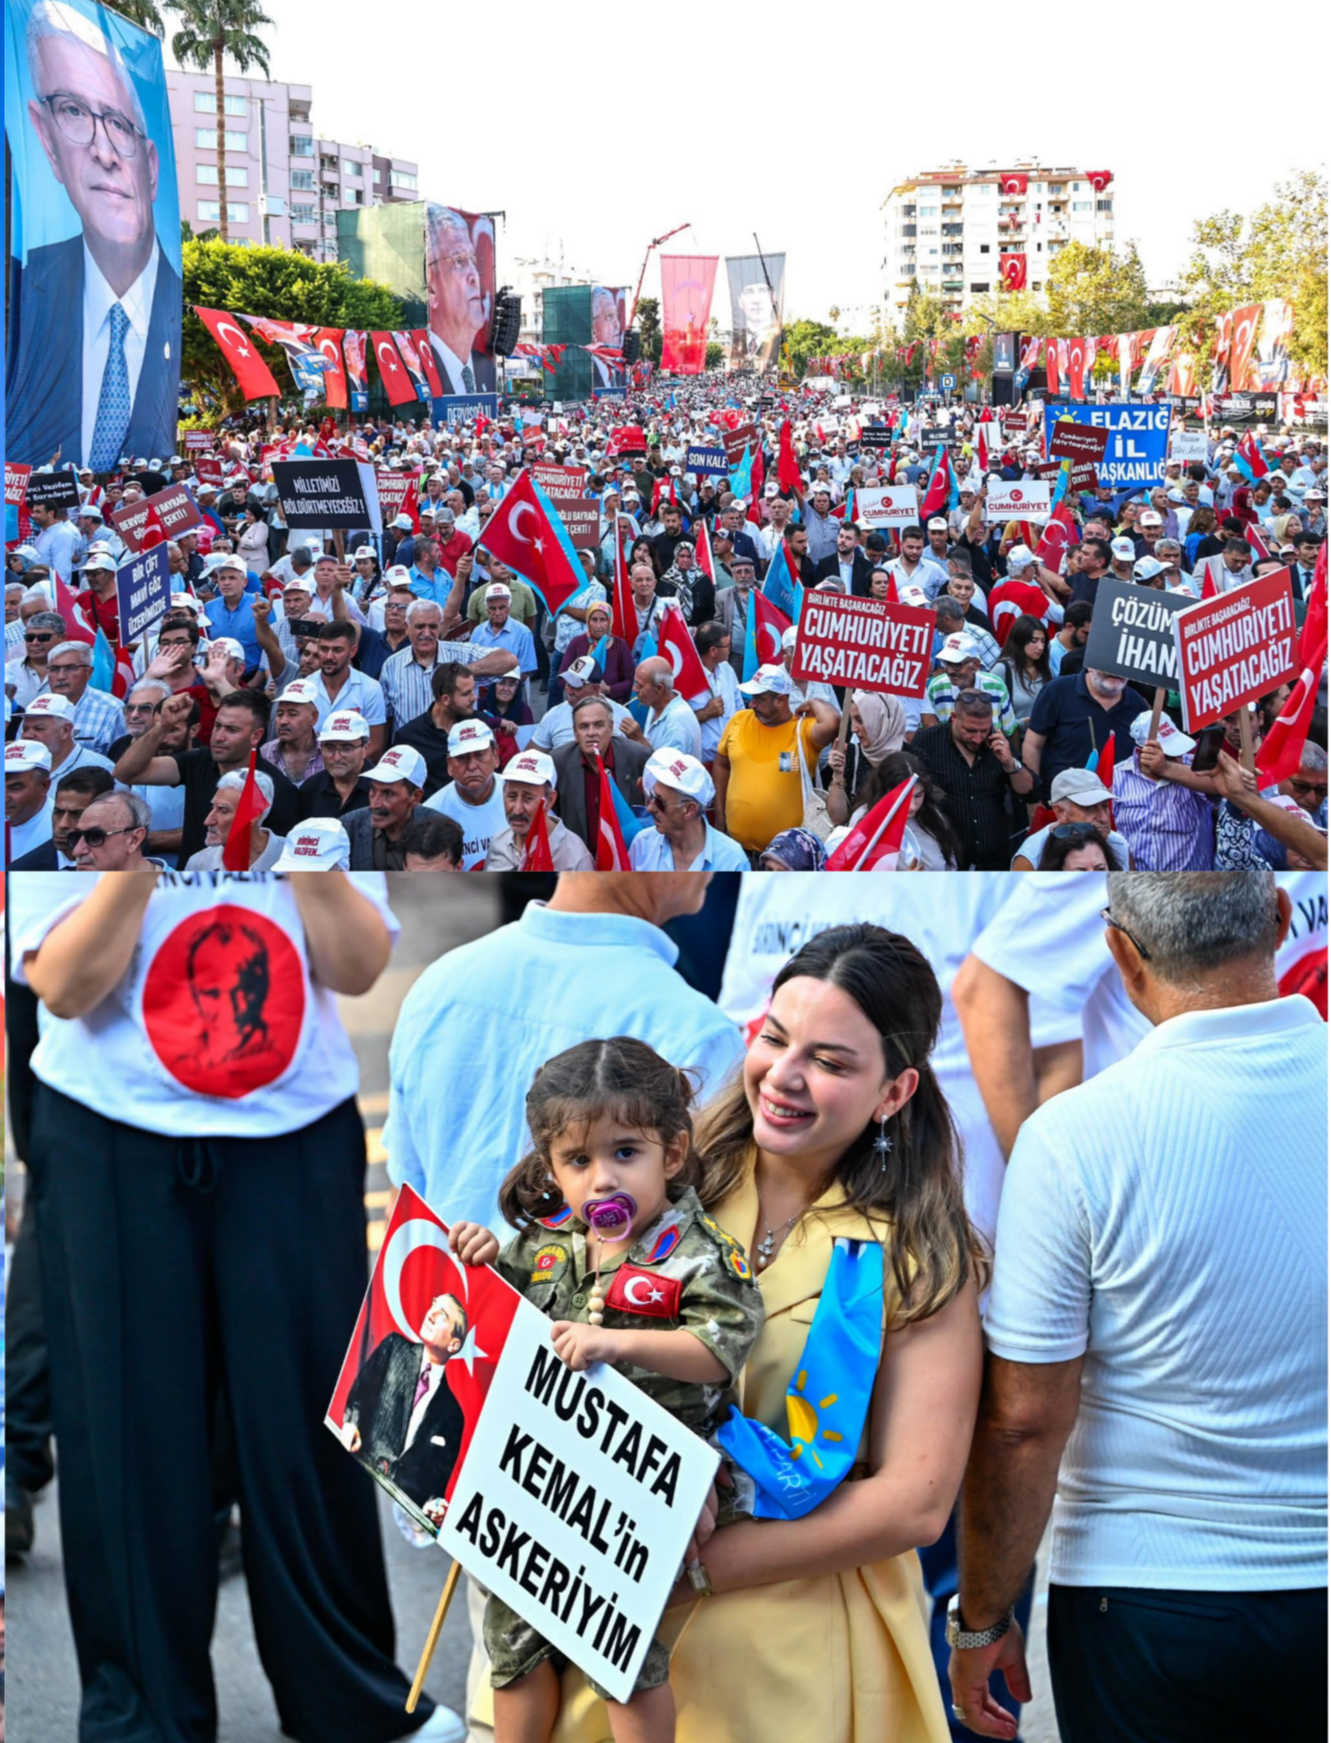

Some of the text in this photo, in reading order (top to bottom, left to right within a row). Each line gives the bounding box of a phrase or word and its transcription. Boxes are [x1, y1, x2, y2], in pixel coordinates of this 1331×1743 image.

[943, 377, 952, 387] D
[1090, 406, 1169, 430] ELAZIĞ
[1114, 435, 1147, 458] İL
[688, 453, 727, 469] SON KALE
[1093, 458, 1166, 485] BAŞKANLIĞ
[292, 475, 341, 494] MİLLETİMİZİ
[377, 477, 419, 491] CUMHURİYTİ
[533, 471, 583, 487] CUMHURİYETİ
[862, 506, 916, 518] CUMHURİYET
[988, 500, 1049, 512] CUMHURİYET
[132, 554, 158, 584] BİR ÇİFT
[130, 574, 162, 610] MAVİ GÖZ
[807, 592, 839, 608] BİRLİKTE
[839, 598, 886, 616] BAŞARACAĞIZ
[1183, 596, 1251, 639] BİRLİKTE BAŞARACAĞIZ
[803, 607, 931, 656] CUMHURİYETİ
[1186, 590, 1292, 677] CUMHURİYETİ
[800, 641, 923, 690] YAŞATACAĞIZ
[1116, 628, 1179, 680] İHAN
[1189, 636, 1294, 718] YAŞATACAĞIZ
[524, 1343, 683, 1509] MUSTAFA
[454, 1490, 643, 1675] ASKERİYİM
